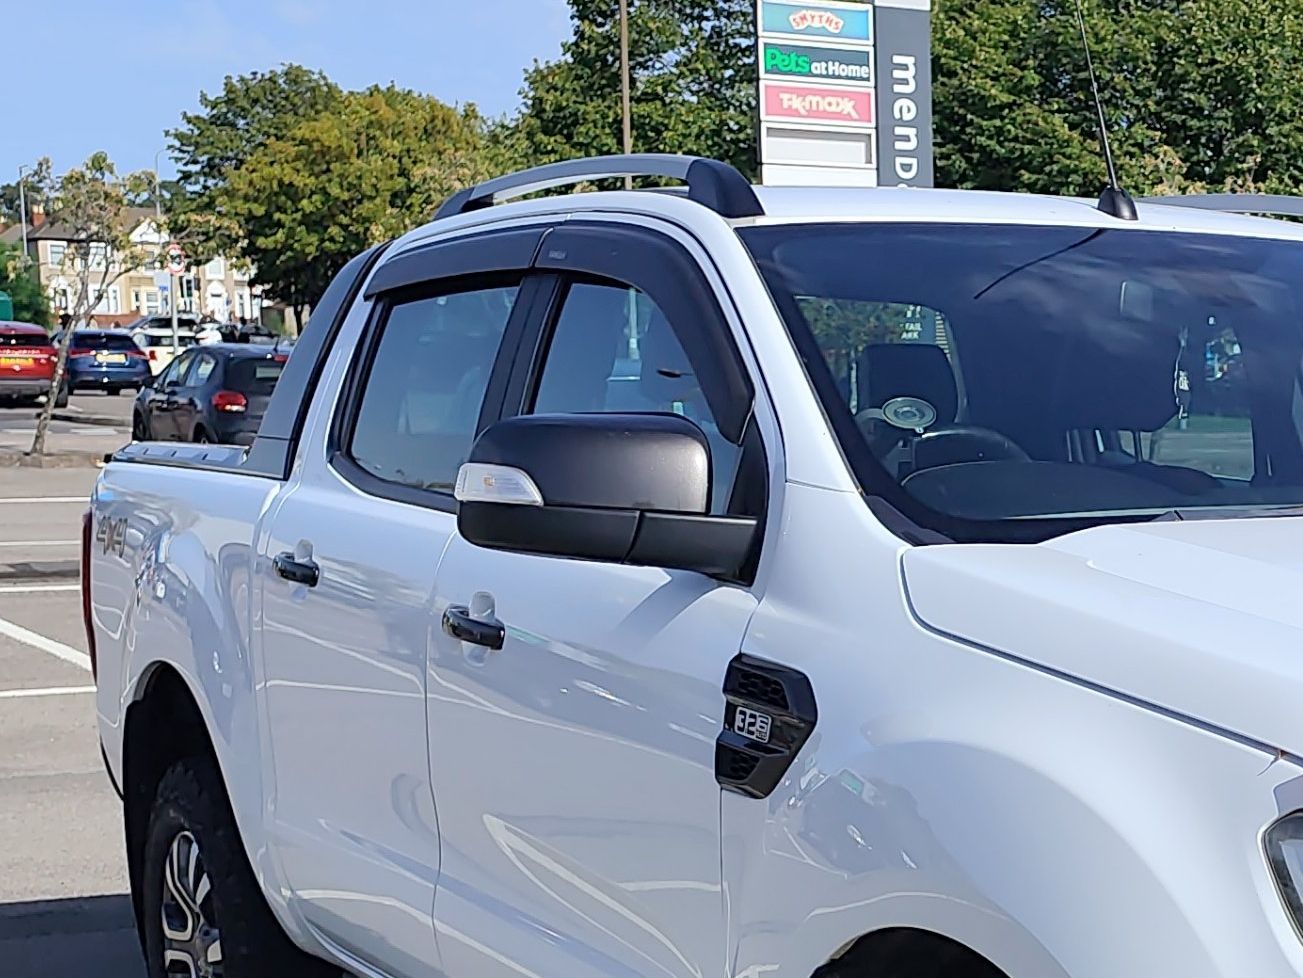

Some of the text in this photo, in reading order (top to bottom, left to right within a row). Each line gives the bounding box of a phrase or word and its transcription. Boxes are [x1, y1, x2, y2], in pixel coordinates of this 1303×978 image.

[791, 13, 841, 31] SMYTHS
[764, 47, 870, 78] Pets at Home
